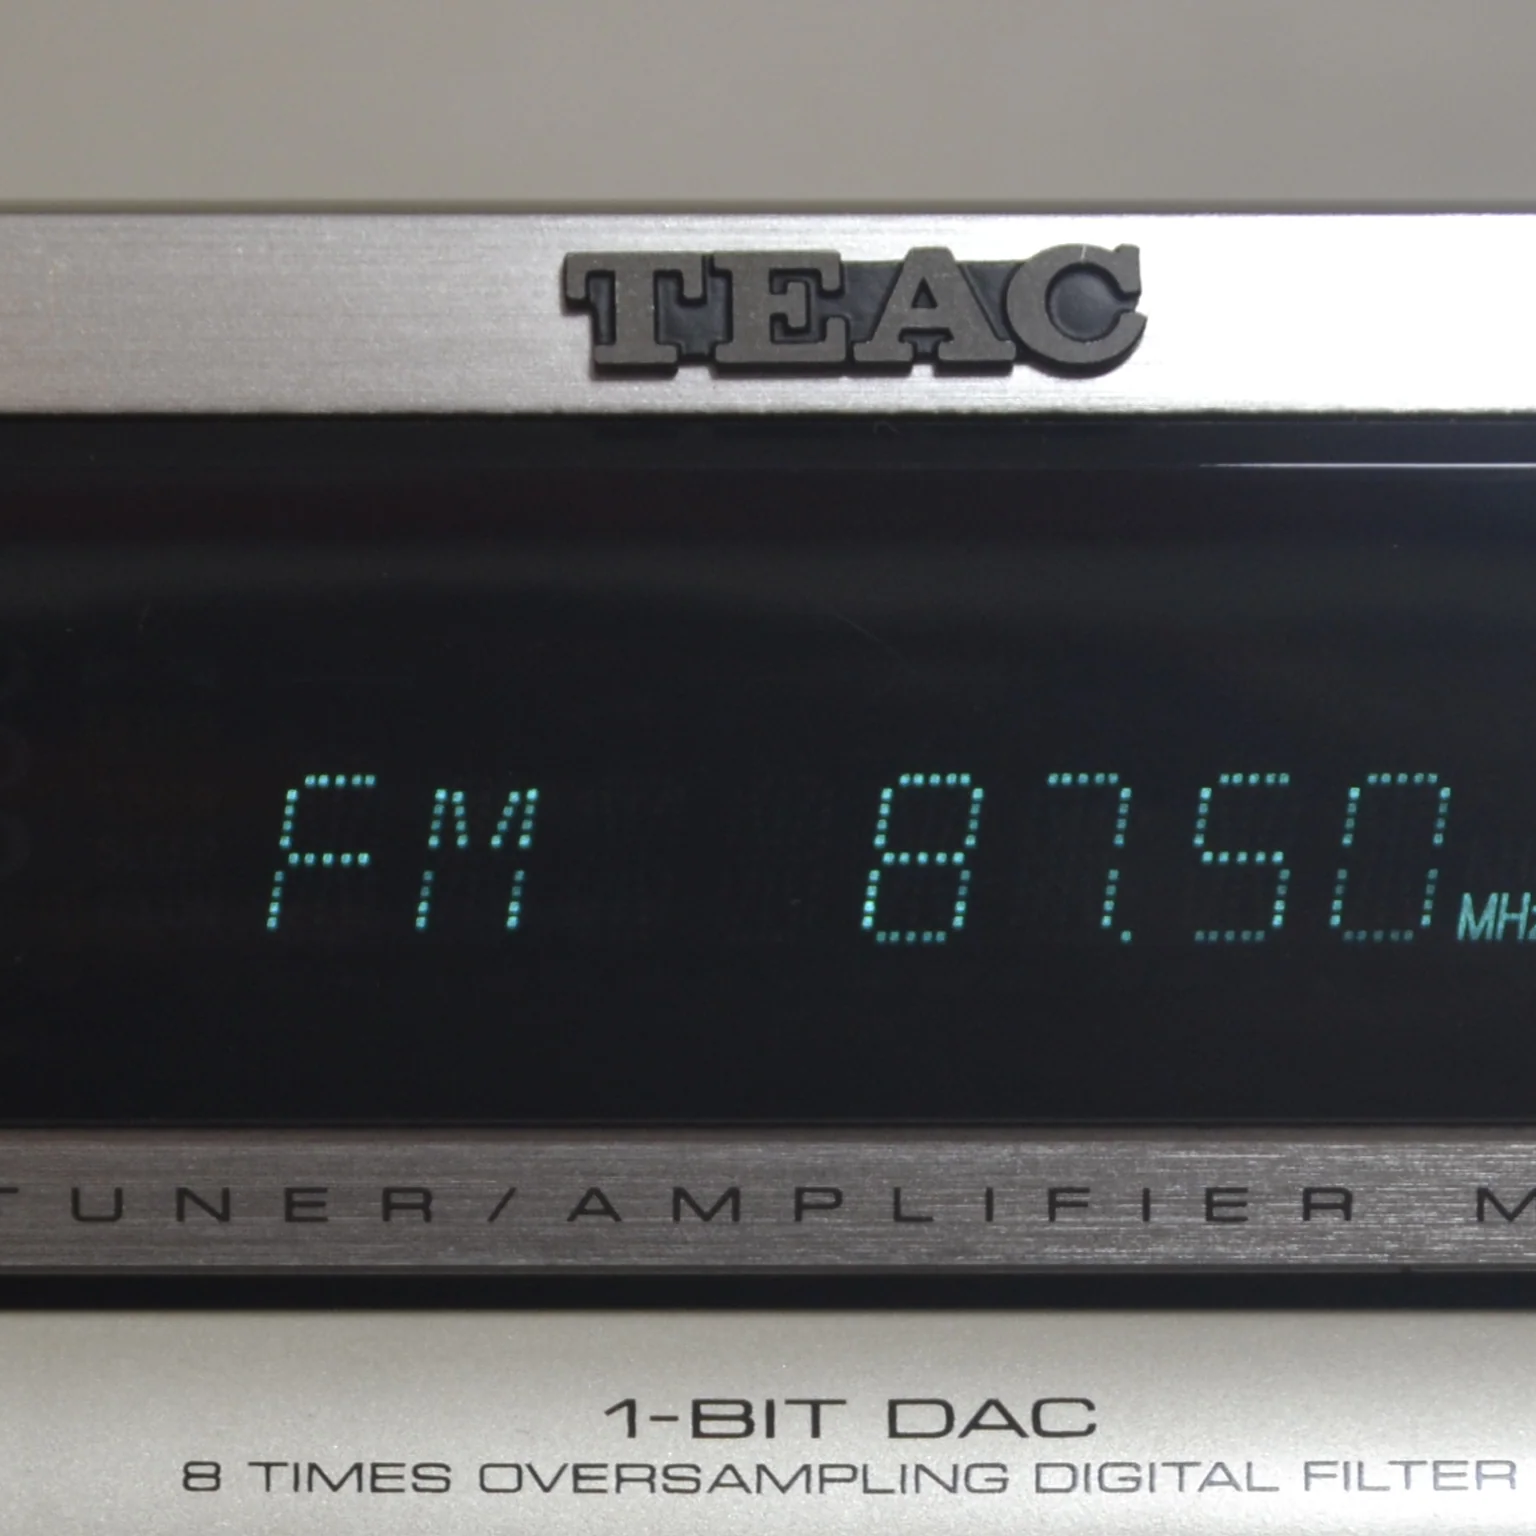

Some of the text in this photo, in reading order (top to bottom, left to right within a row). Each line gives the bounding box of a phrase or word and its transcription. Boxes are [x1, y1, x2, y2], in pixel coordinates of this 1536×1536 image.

[560, 242, 1149, 379] TEAC
[266, 773, 539, 930] FM
[860, 772, 1452, 943] 87.50
[604, 1397, 1097, 1440] 1-BIT DAC
[182, 1459, 1517, 1495] 8 TIMES OVERSAMPLING DIGITAL FILTER
